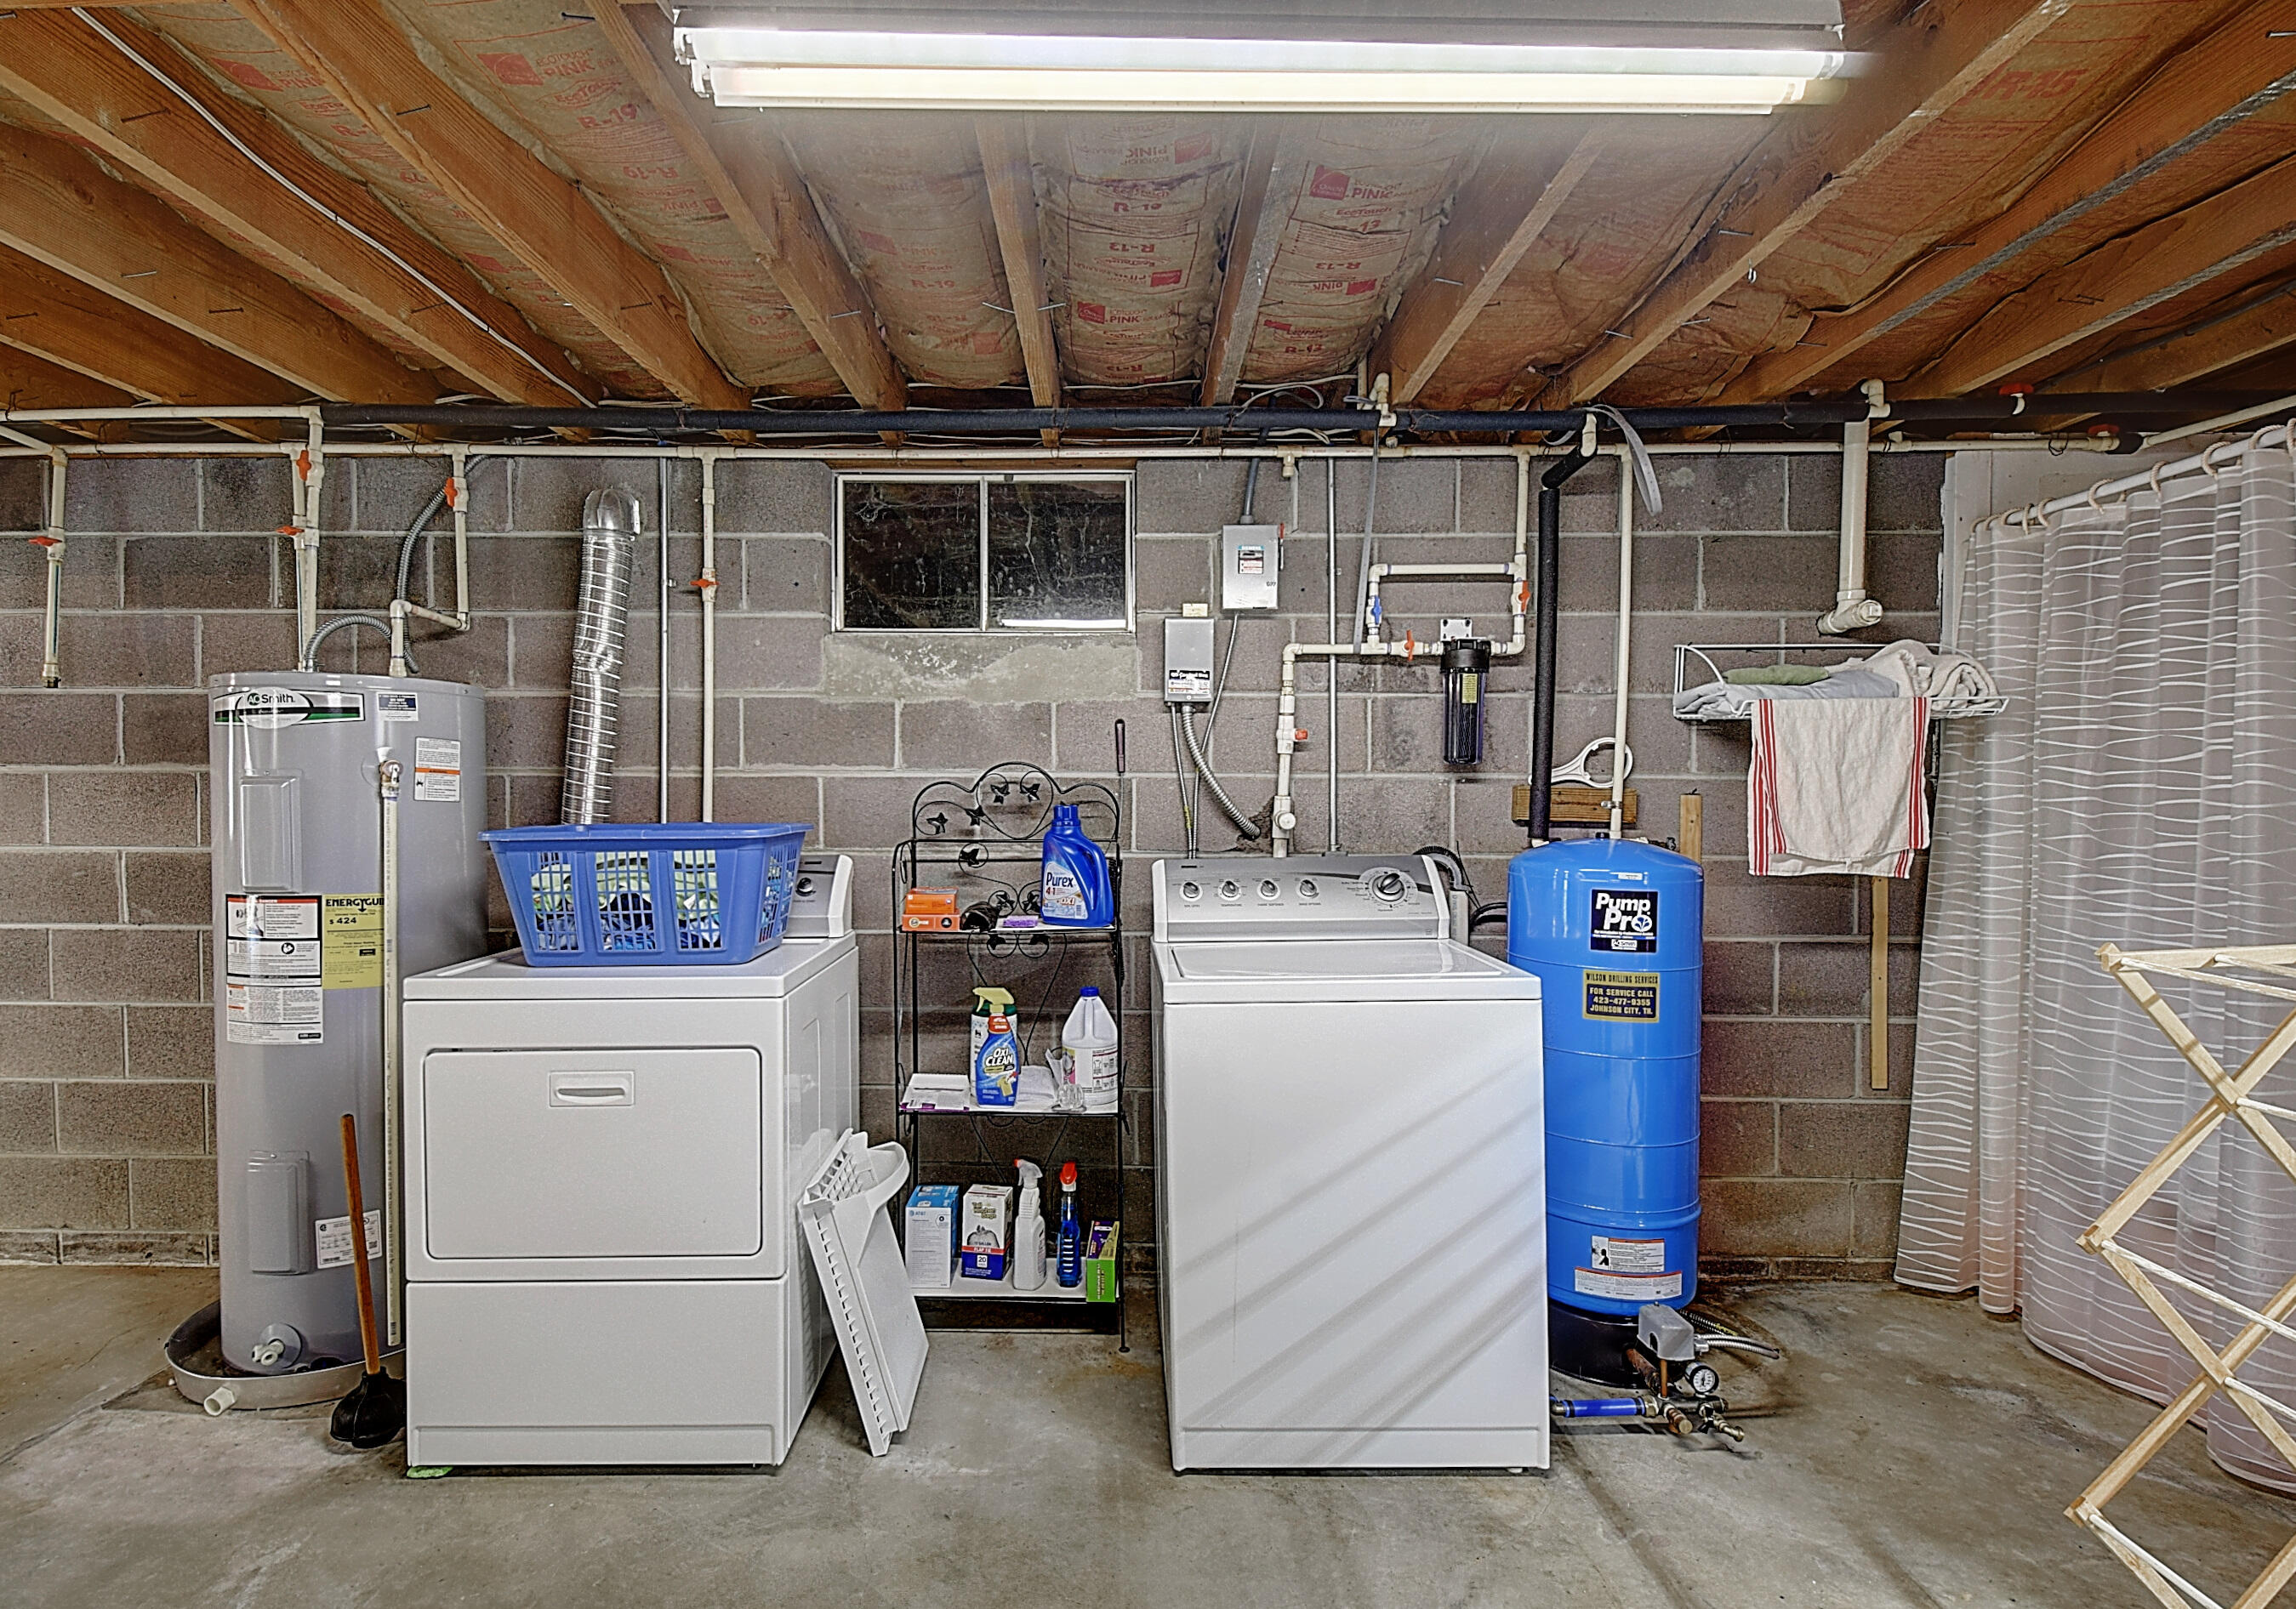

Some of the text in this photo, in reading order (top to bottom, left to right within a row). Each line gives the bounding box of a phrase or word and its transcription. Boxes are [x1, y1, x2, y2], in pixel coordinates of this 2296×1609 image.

[544, 59, 595, 77] PINK
[577, 103, 637, 128] R-19
[1127, 145, 1167, 157] PINK
[623, 165, 678, 179] R-19
[1351, 187, 1390, 199] PINK
[1315, 261, 1361, 270] R-13
[261, 693, 293, 703] Smith
[1046, 872, 1074, 887] Purex
[1061, 897, 1075, 906] OXI
[1595, 892, 1651, 916] Pump
[1603, 907, 1653, 933] Pro
[1586, 973, 1606, 981] WILSON
[1609, 975, 1632, 983] DRILLING
[1605, 988, 1635, 997] SERVICE
[1590, 1004, 1622, 1014] JOHNSON
[994, 1048, 1009, 1057] OXI
[985, 1055, 1013, 1066] CLEAN
